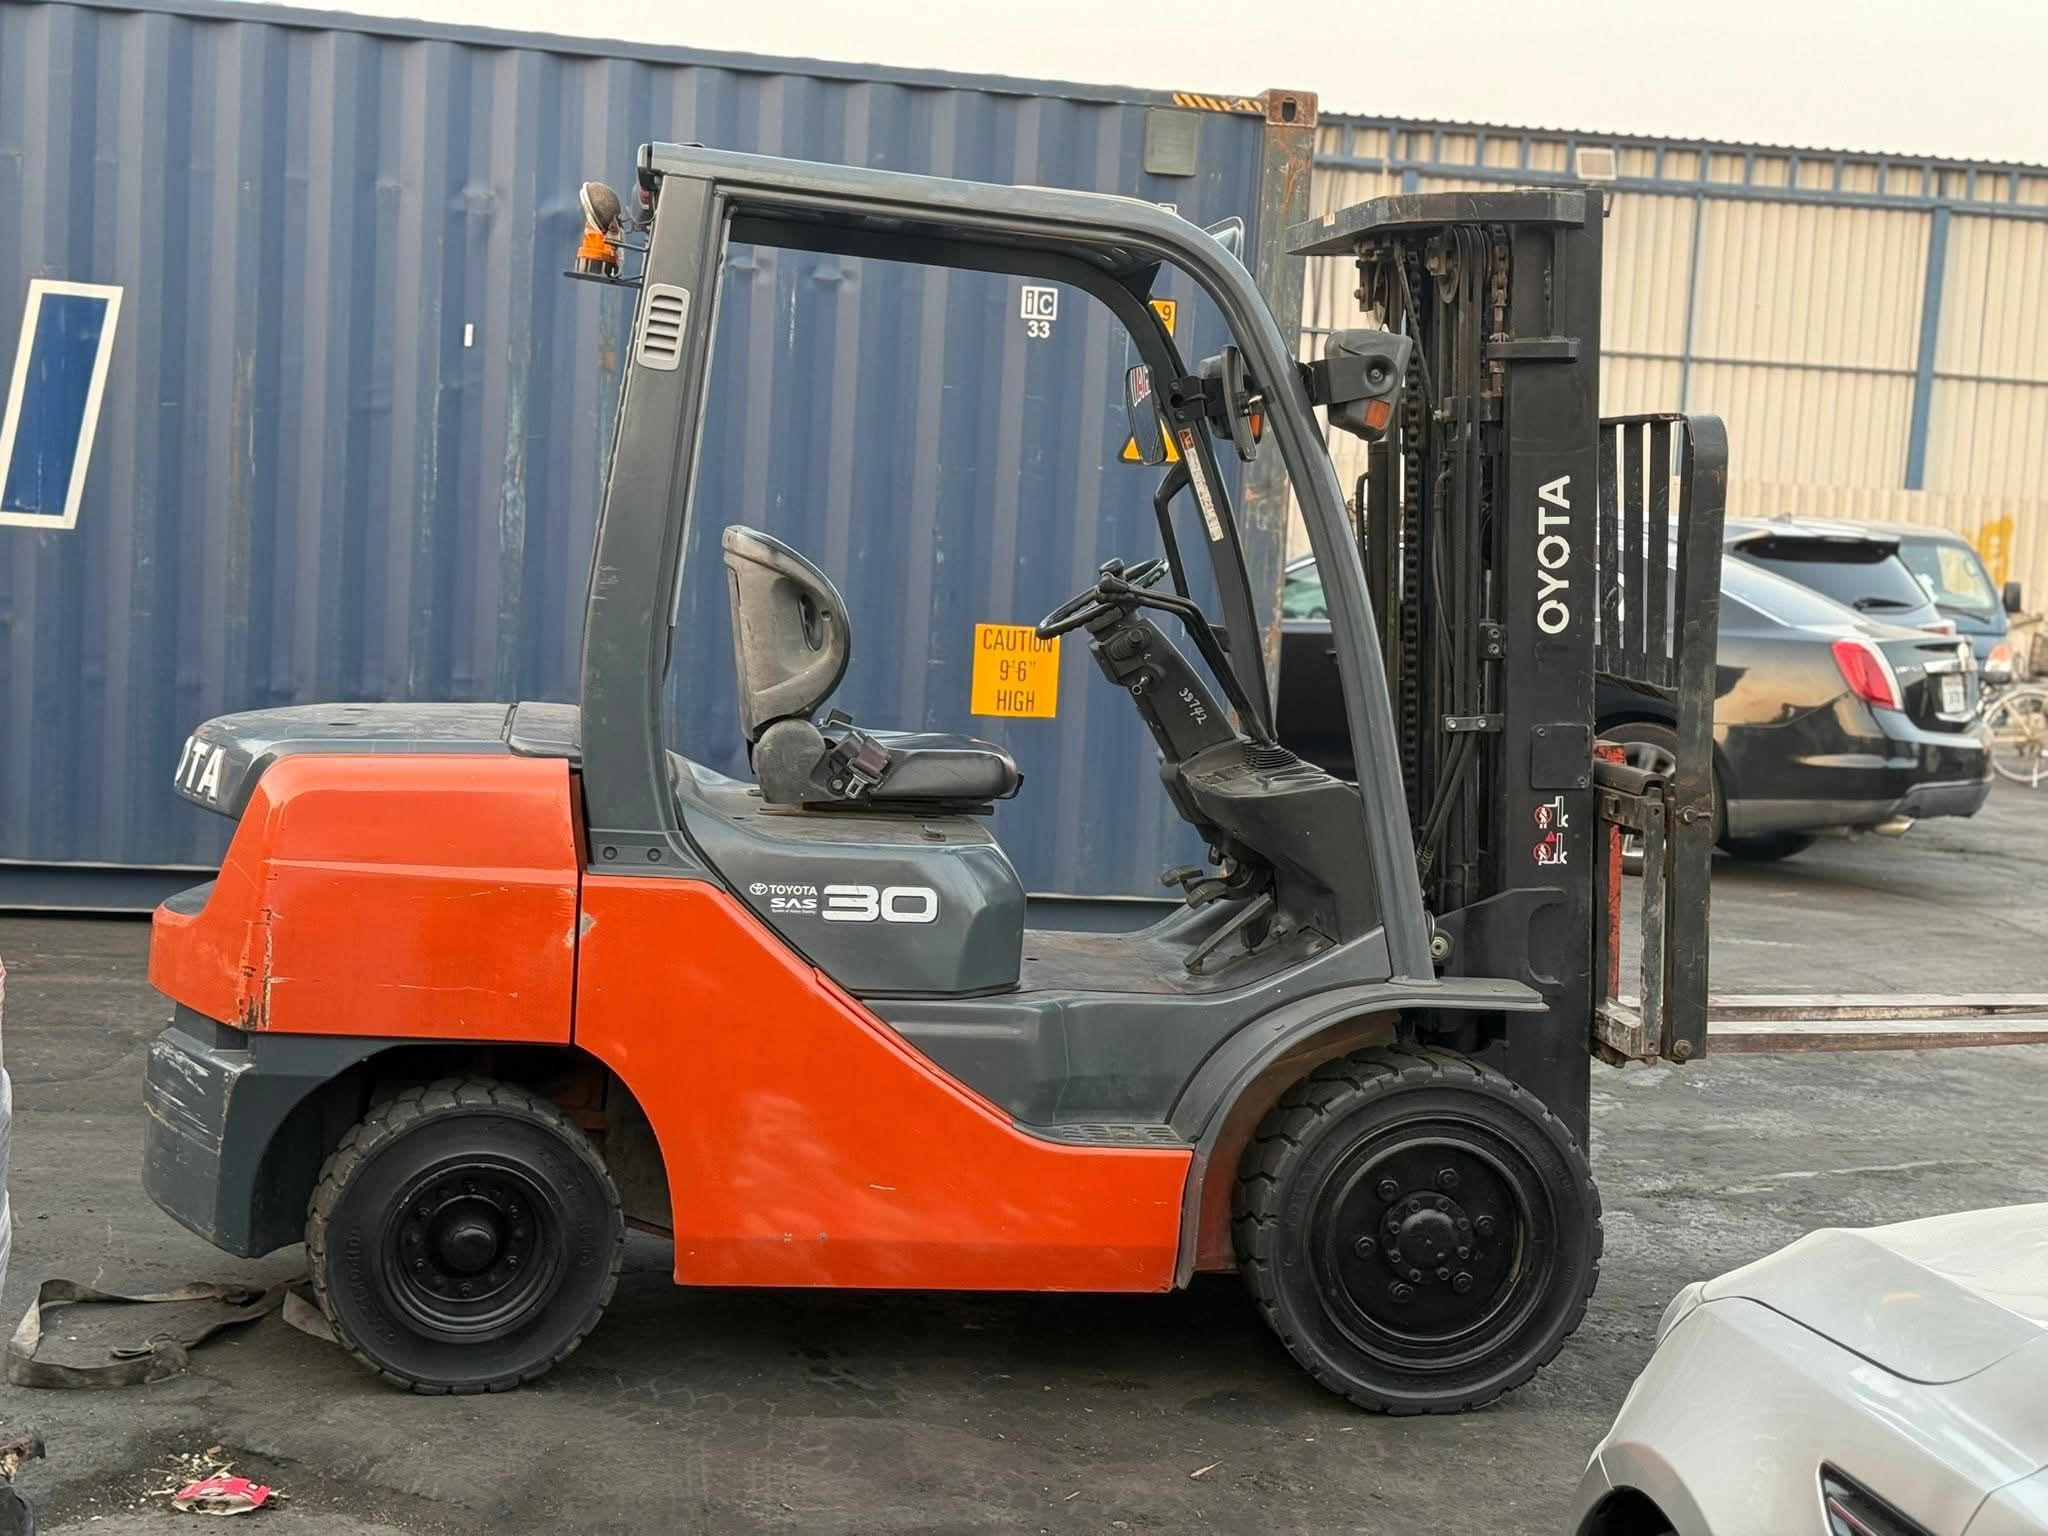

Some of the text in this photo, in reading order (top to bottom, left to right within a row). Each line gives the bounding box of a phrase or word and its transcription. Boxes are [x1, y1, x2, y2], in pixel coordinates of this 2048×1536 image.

[1027, 320, 1050, 339] 33
[1537, 475, 1571, 635] OYOTA
[996, 689, 1036, 713] HIGH
[769, 884, 818, 896] TOYOTA
[770, 897, 818, 909] SAS
[821, 884, 938, 923] 30
